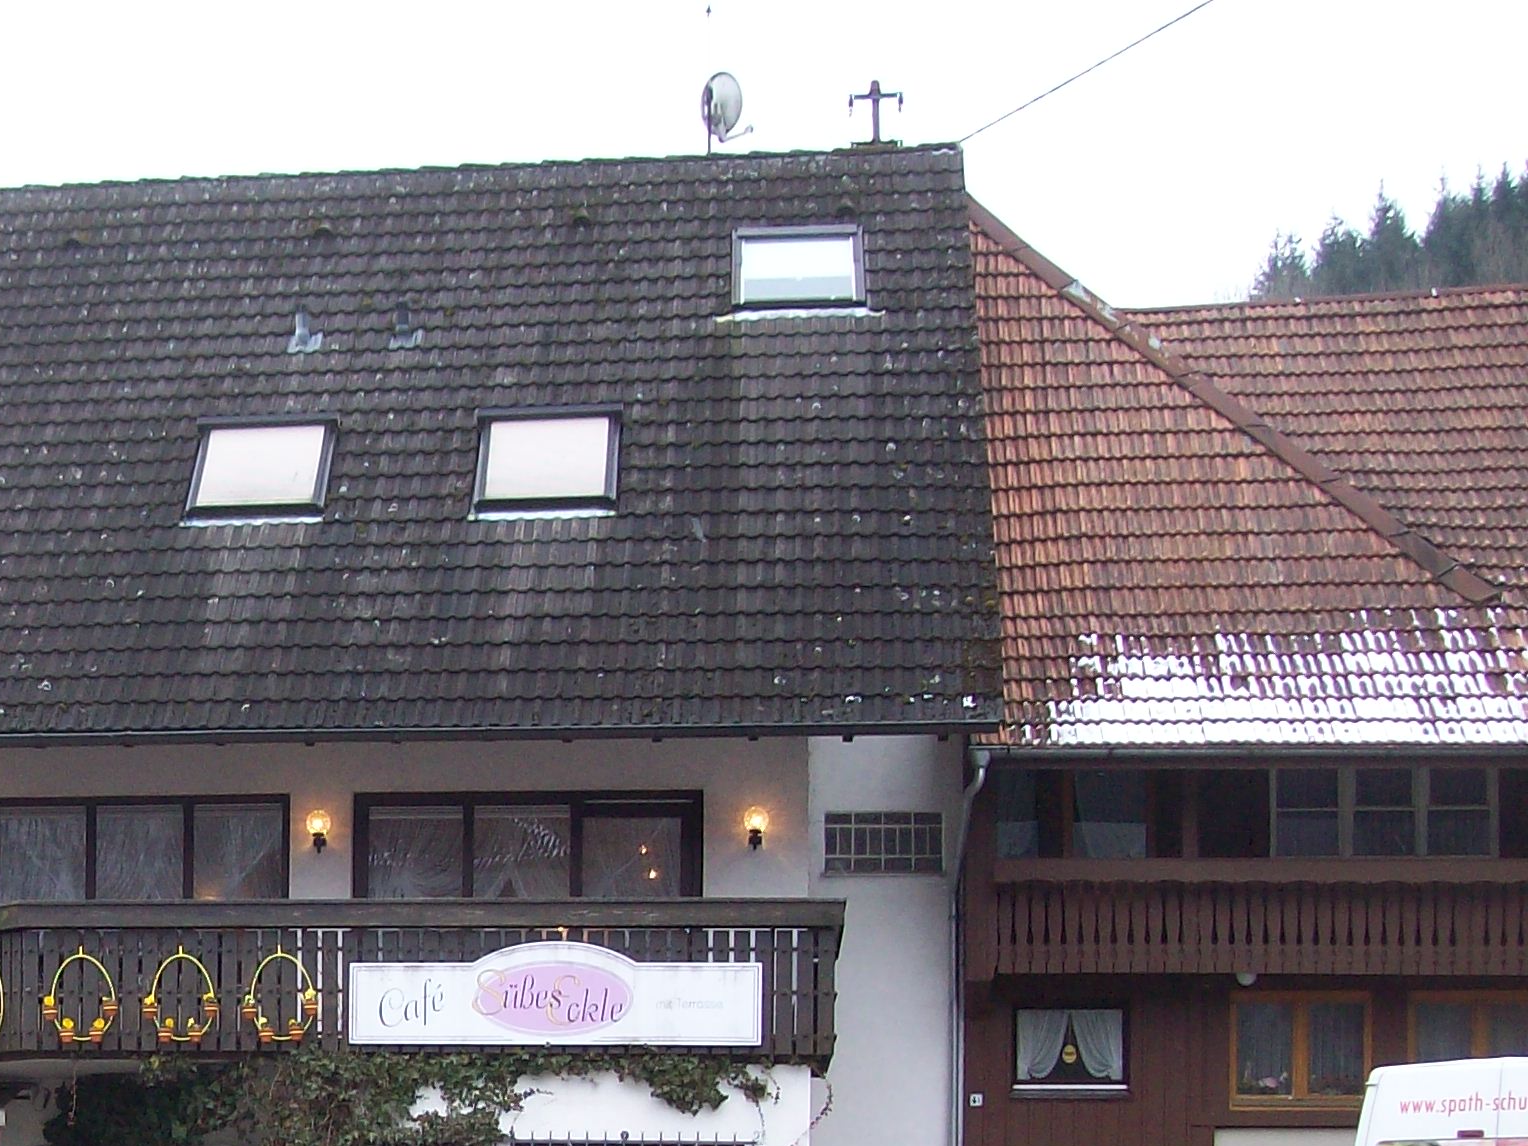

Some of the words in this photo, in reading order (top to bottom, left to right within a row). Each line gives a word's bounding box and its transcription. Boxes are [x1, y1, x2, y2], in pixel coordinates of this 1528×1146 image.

[378, 978, 444, 1028] Café
[472, 969, 562, 1016] Süßes
[545, 974, 624, 1026] Eckle
